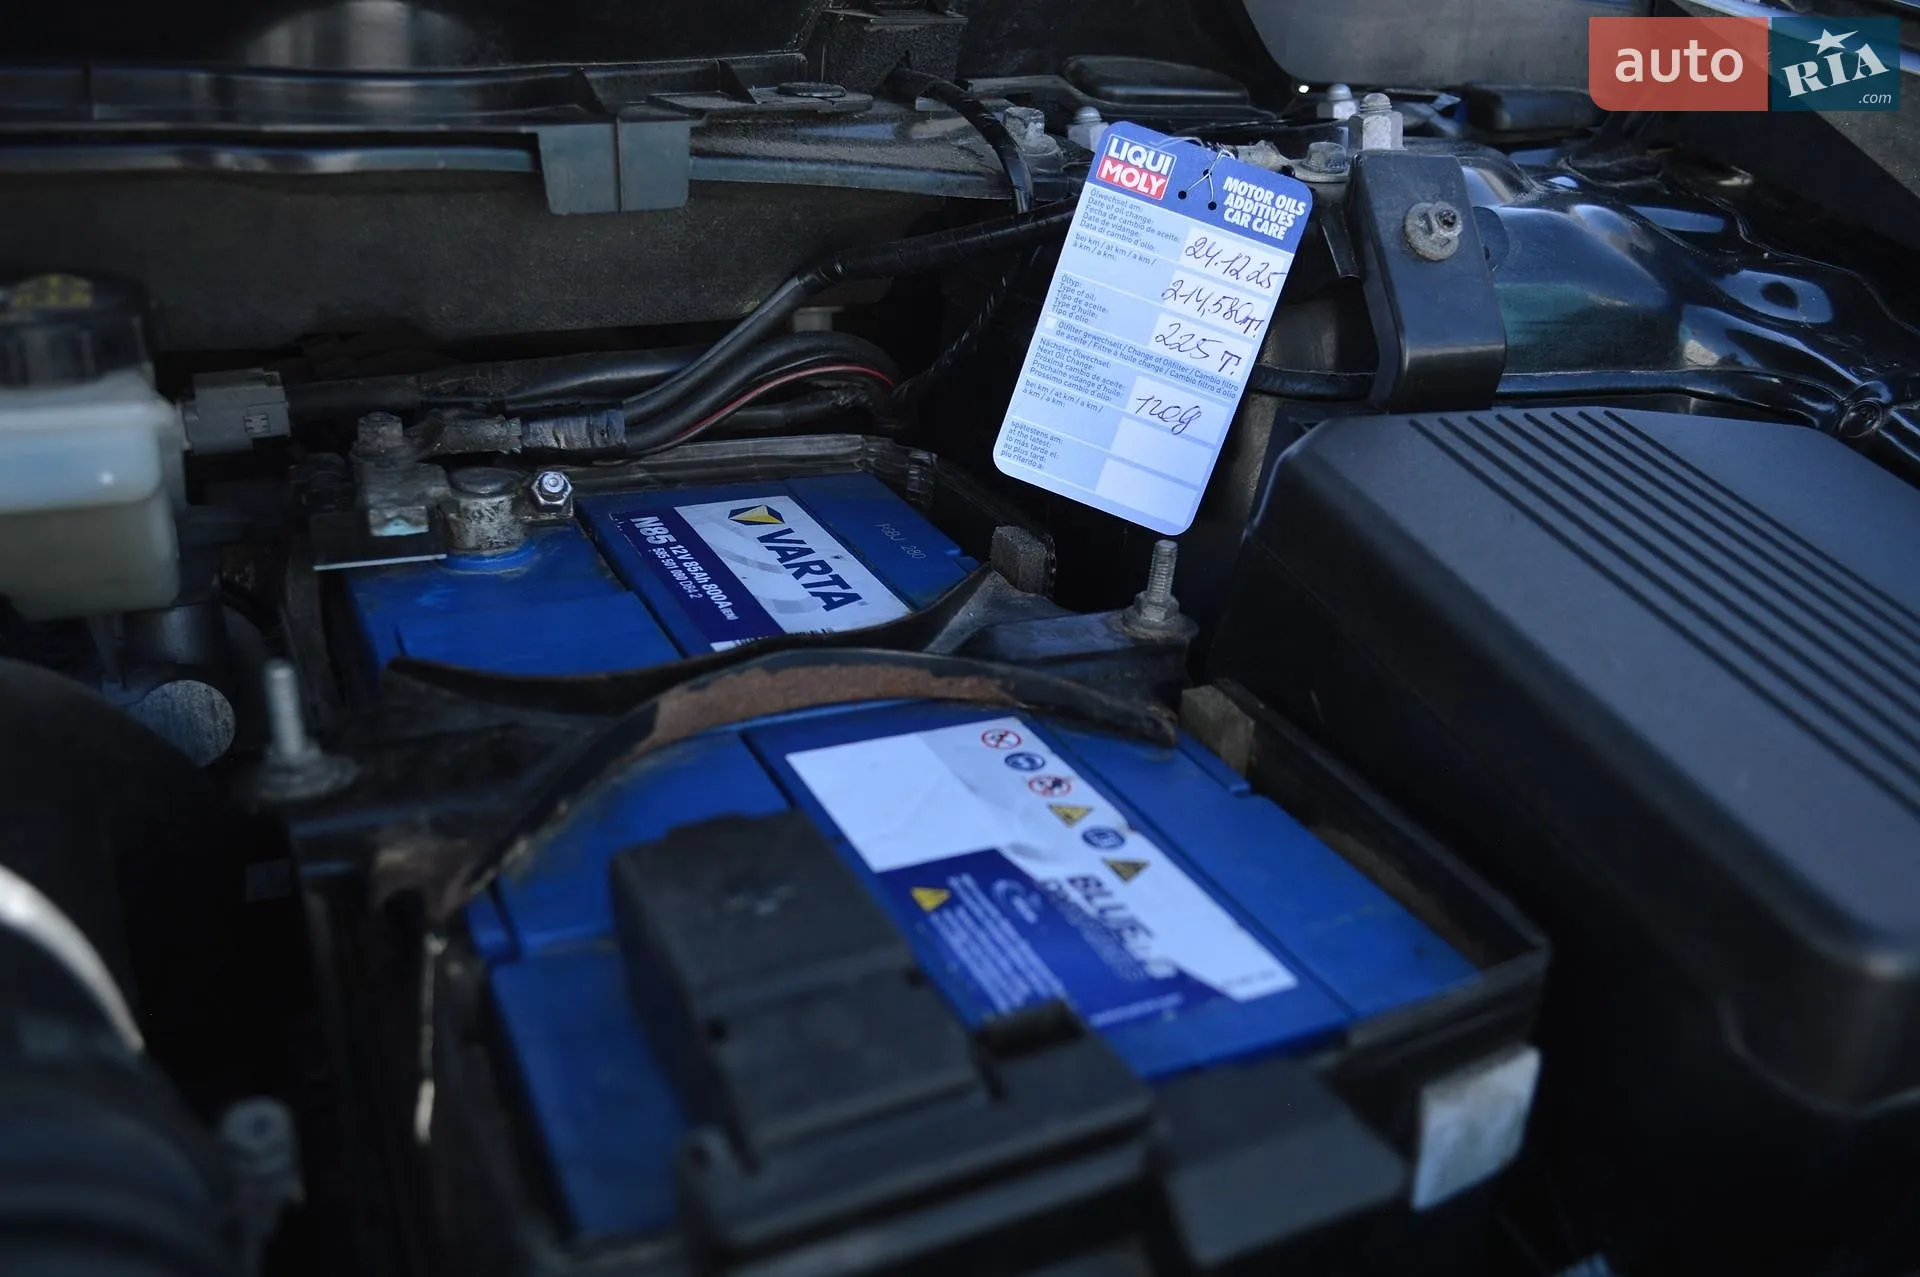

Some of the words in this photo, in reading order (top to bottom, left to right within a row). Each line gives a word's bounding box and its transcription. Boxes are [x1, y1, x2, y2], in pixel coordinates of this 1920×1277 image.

[1106, 137, 1172, 177] LIQUI
[1099, 158, 1166, 198] MOLY
[1087, 196, 1105, 208] Date
[1113, 205, 1125, 215] oil
[1222, 175, 1275, 205] MOTOR
[1273, 193, 1307, 217] OILS
[1081, 211, 1100, 223] Date
[1100, 217, 1110, 227] de
[1084, 203, 1108, 217] Fecha
[1107, 212, 1117, 221] de
[1118, 215, 1145, 230] cambio
[1145, 225, 1155, 234] de
[1222, 191, 1296, 228] ADDITIVES
[1079, 218, 1097, 231] Data
[1097, 225, 1105, 233] di
[1105, 228, 1133, 243] cambio
[1221, 206, 1252, 228] CAR
[1250, 216, 1287, 240] CARE
[1078, 241, 1091, 251] km
[1087, 236, 1100, 246] km
[1114, 245, 1127, 256] km
[1138, 254, 1151, 264] km
[1055, 289, 1072, 301] Tipo
[1072, 296, 1082, 305] de
[1058, 282, 1076, 294] Type
[1076, 288, 1084, 297] of
[1051, 305, 1067, 316] Tipo
[1053, 297, 1071, 309] Type
[1037, 344, 1054, 356] Next
[1054, 351, 1065, 360] Oil
[1055, 329, 1063, 337] de
[1065, 332, 1087, 345] aceite
[1092, 342, 1112, 354] Filtre
[1118, 351, 1138, 363] huile
[1169, 369, 1197, 384] Cambio
[1197, 379, 1215, 391] filtro
[1126, 345, 1154, 362] Change
[1193, 369, 1221, 384] Cambio
[1029, 366, 1063, 384] Prossimo
[1063, 378, 1090, 393] cambio
[1031, 359, 1068, 377] Prochaine
[1067, 372, 1096, 389] vidange
[1064, 362, 1091, 377] cambio
[1091, 371, 1101, 381] de
[1028, 389, 1040, 398] km
[1037, 383, 1049, 393] km
[1063, 392, 1075, 402] km
[1086, 401, 1098, 410] km
[1016, 430, 1028, 440] the
[1012, 445, 1029, 456] plus
[1012, 453, 1037, 467] ritardo
[1029, 443, 1049, 455] tarde
[630, 516, 677, 544] N85
[669, 545, 694, 560] 12V
[683, 561, 711, 583] 85Ah
[756, 528, 862, 612] VARTA
